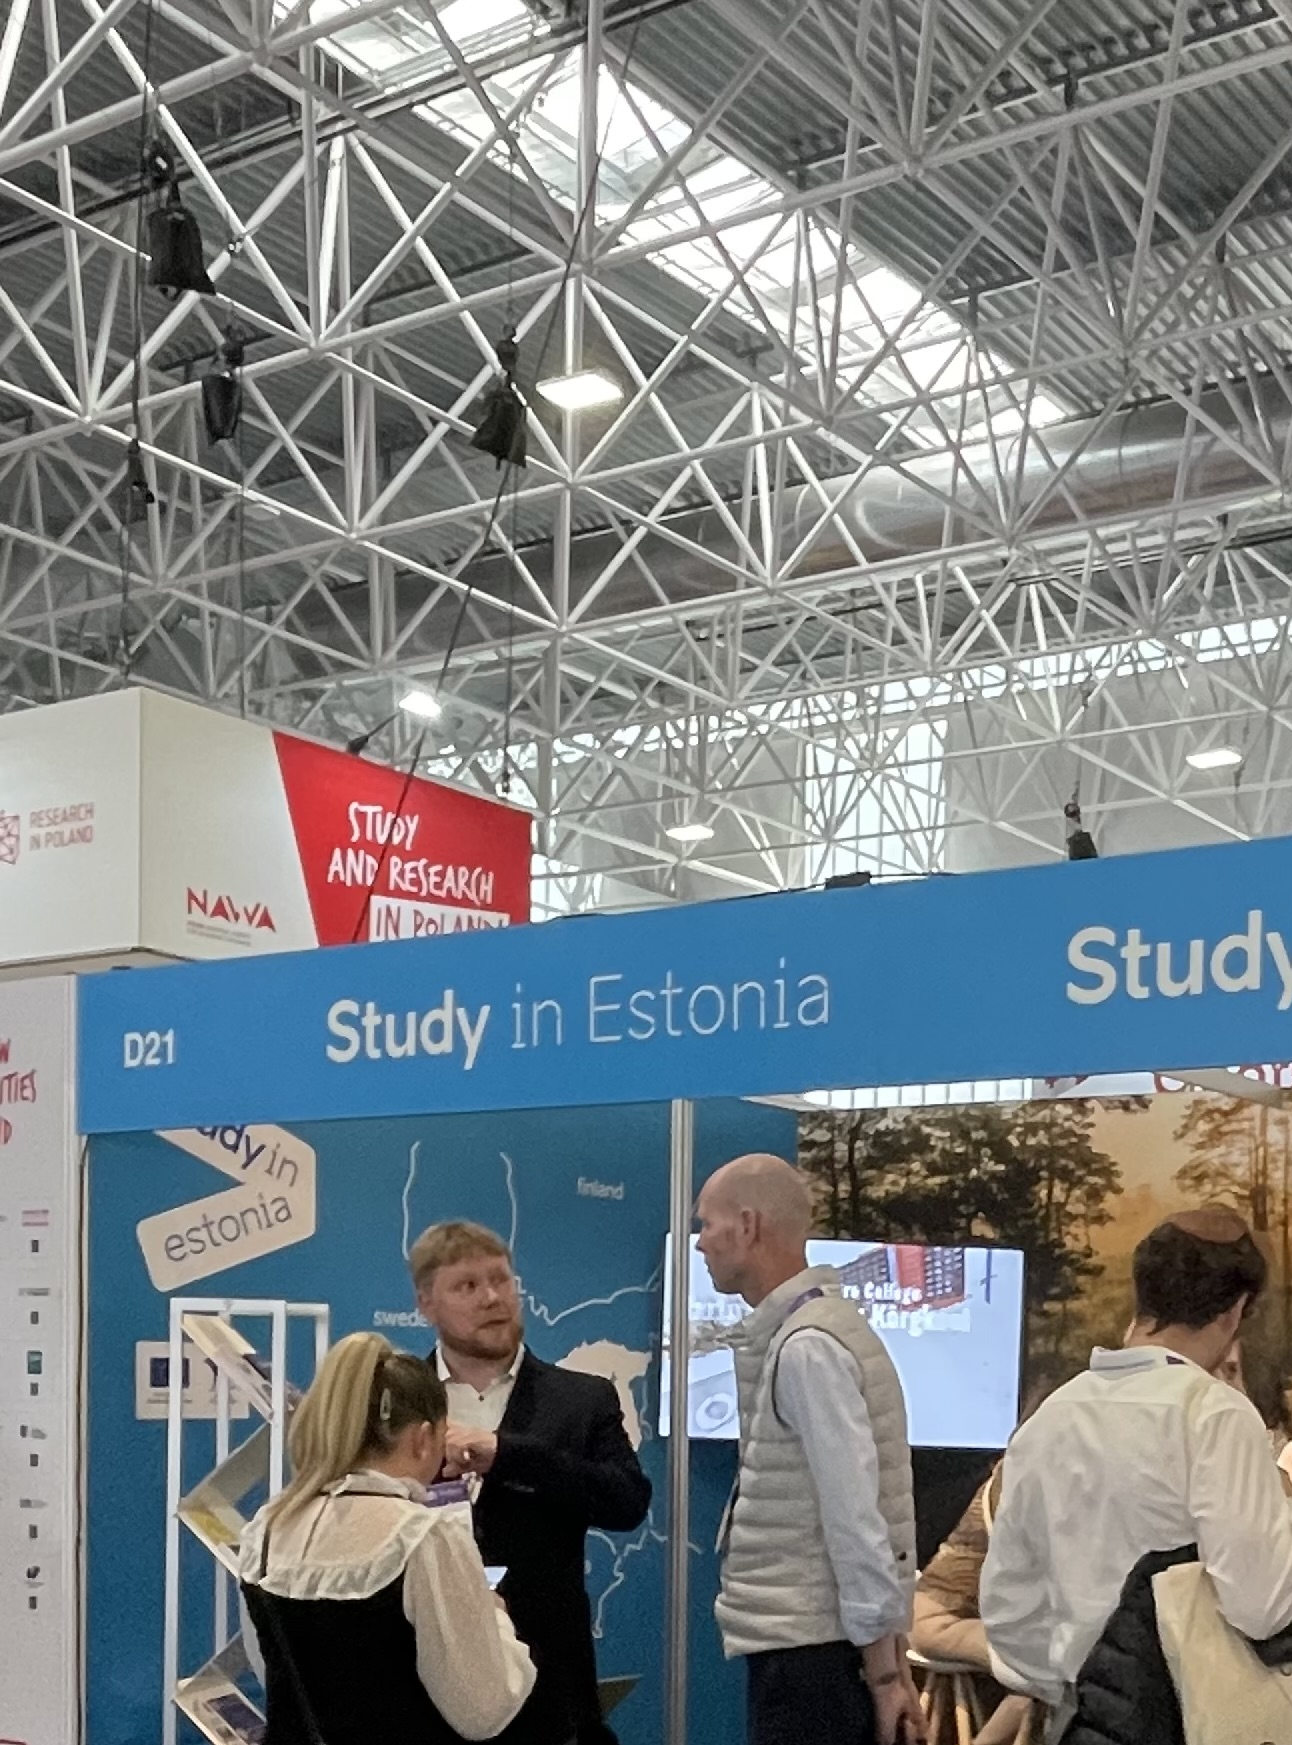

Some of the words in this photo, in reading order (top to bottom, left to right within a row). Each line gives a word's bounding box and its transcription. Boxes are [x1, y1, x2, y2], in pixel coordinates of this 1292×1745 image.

[29, 802, 95, 829] RESEARCH
[348, 801, 419, 851] STUDY
[29, 834, 41, 851] IN
[44, 825, 94, 849] POLAND
[327, 847, 379, 887] AND
[388, 855, 495, 906] RESEARCH
[376, 904, 400, 937] IN
[413, 909, 504, 936] POLA
[325, 989, 491, 1071] Study
[511, 981, 563, 1049] in
[588, 957, 830, 1044] Estonia
[123, 1028, 176, 1069] D21
[264, 1142, 299, 1187] in
[576, 1176, 625, 1200] finland
[164, 1192, 293, 1262] estonia
[372, 1307, 433, 1328] swede
